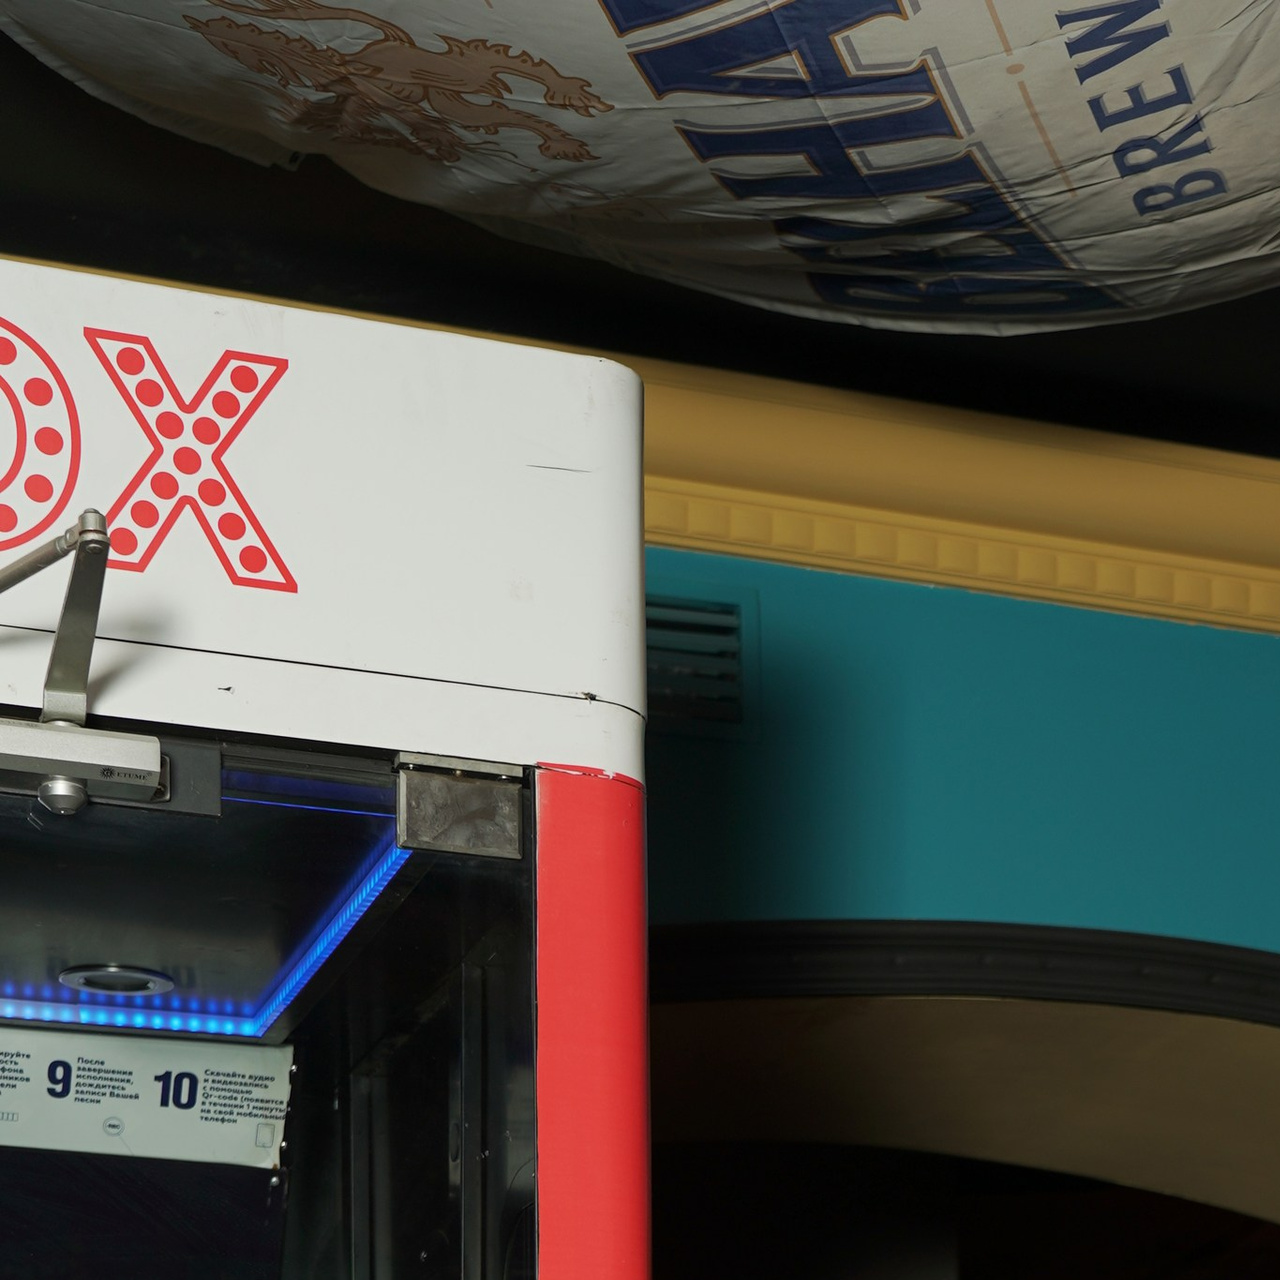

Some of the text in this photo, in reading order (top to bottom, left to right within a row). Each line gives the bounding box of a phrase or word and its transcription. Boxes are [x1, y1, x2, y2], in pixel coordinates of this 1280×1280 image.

[1055, 0, 1229, 216] BREW
[77, 1056, 105, 1066] После
[77, 1066, 133, 1077] завершения
[204, 1068, 276, 1083] Скачайте аудио
[46, 1059, 73, 1099] 9
[76, 1073, 134, 1085] исполнения,
[211, 1078, 269, 1090] видеозапись
[75, 1081, 126, 1091] дождитесь
[154, 1070, 199, 1110] 10
[209, 1086, 253, 1096] помощью
[75, 1089, 140, 1100] записи Вашей
[202, 1091, 284, 1106] Qr-code (появится
[74, 1096, 101, 1105] песни
[208, 1101, 245, 1110] течении
[213, 1109, 235, 1117] свой
[200, 1115, 238, 1125] телефон
